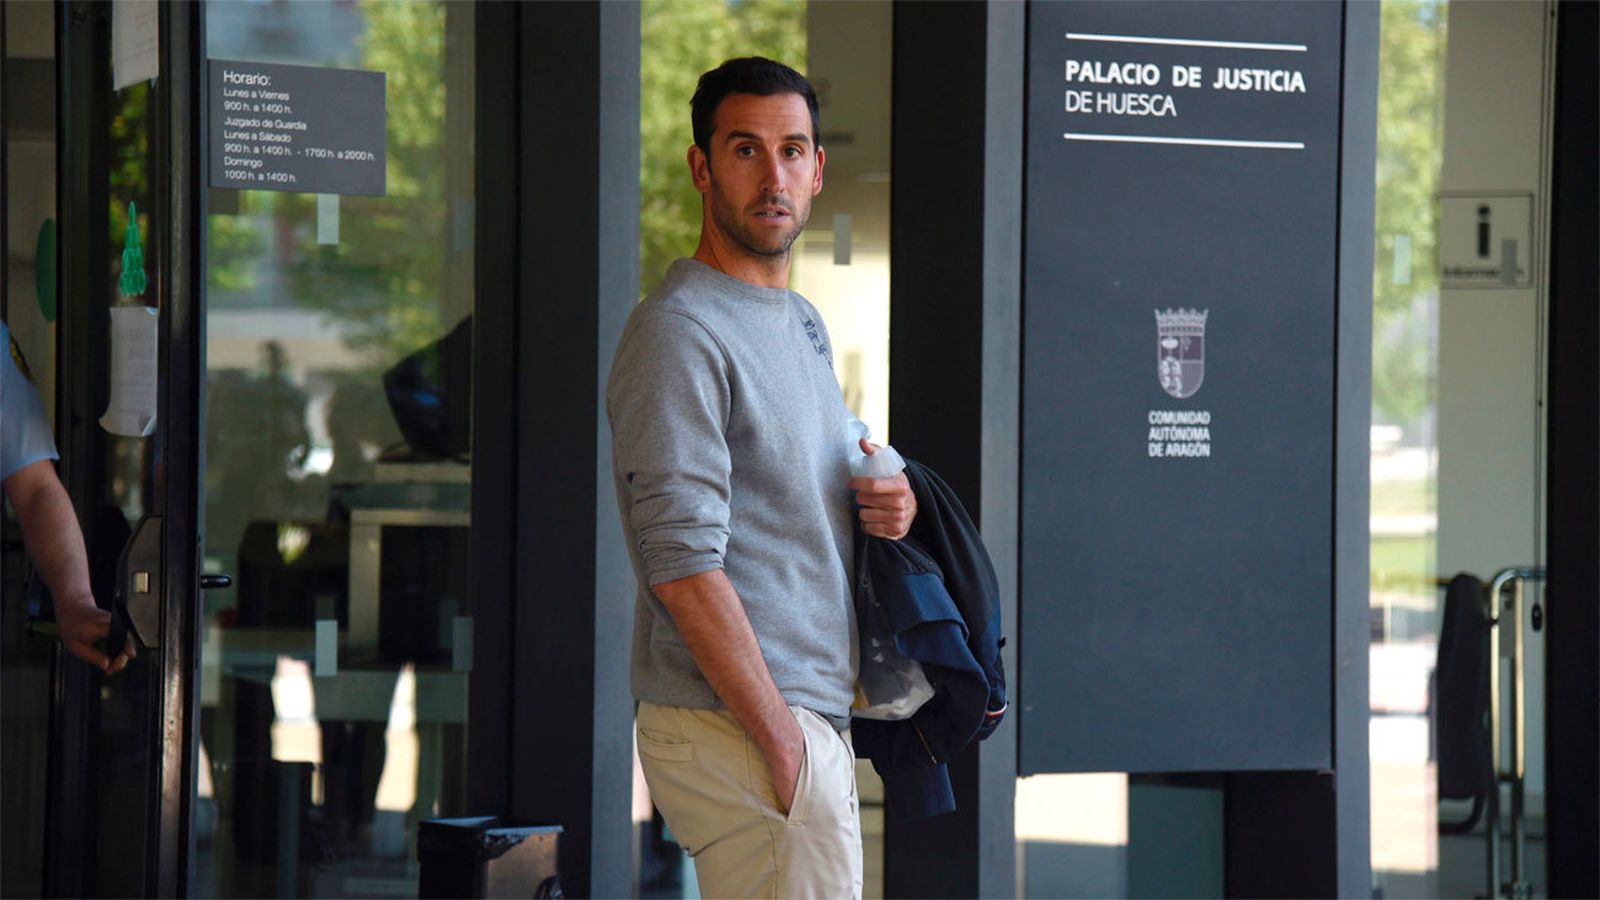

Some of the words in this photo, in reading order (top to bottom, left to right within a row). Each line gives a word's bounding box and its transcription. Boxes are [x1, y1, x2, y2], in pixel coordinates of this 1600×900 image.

[223, 70, 272, 86] Horario:
[1065, 60, 1161, 86] PALACIO
[1172, 65, 1202, 88] DE
[1213, 68, 1306, 93] JUSTICIA
[223, 88, 250, 99] Lunes
[250, 90, 258, 99] a
[259, 90, 290, 101] Viernes
[252, 104, 260, 113] a
[1065, 90, 1093, 113] DE
[1096, 92, 1177, 117] HUESCA
[224, 116, 261, 129] Juzgado
[261, 119, 274, 128] de
[274, 119, 308, 130] Guardia
[223, 130, 250, 140] Lunes
[250, 132, 258, 141] a
[258, 131, 292, 142] Sábado
[253, 146, 260, 154] a
[336, 151, 344, 160] a
[224, 156, 263, 169] Domingo
[258, 172, 265, 181] a
[1148, 409, 1211, 426] COMUNIDAD
[1148, 425, 1211, 442] AUTÓNOMA
[1148, 442, 1164, 457] DE
[1165, 440, 1211, 457] ARAGÓN
